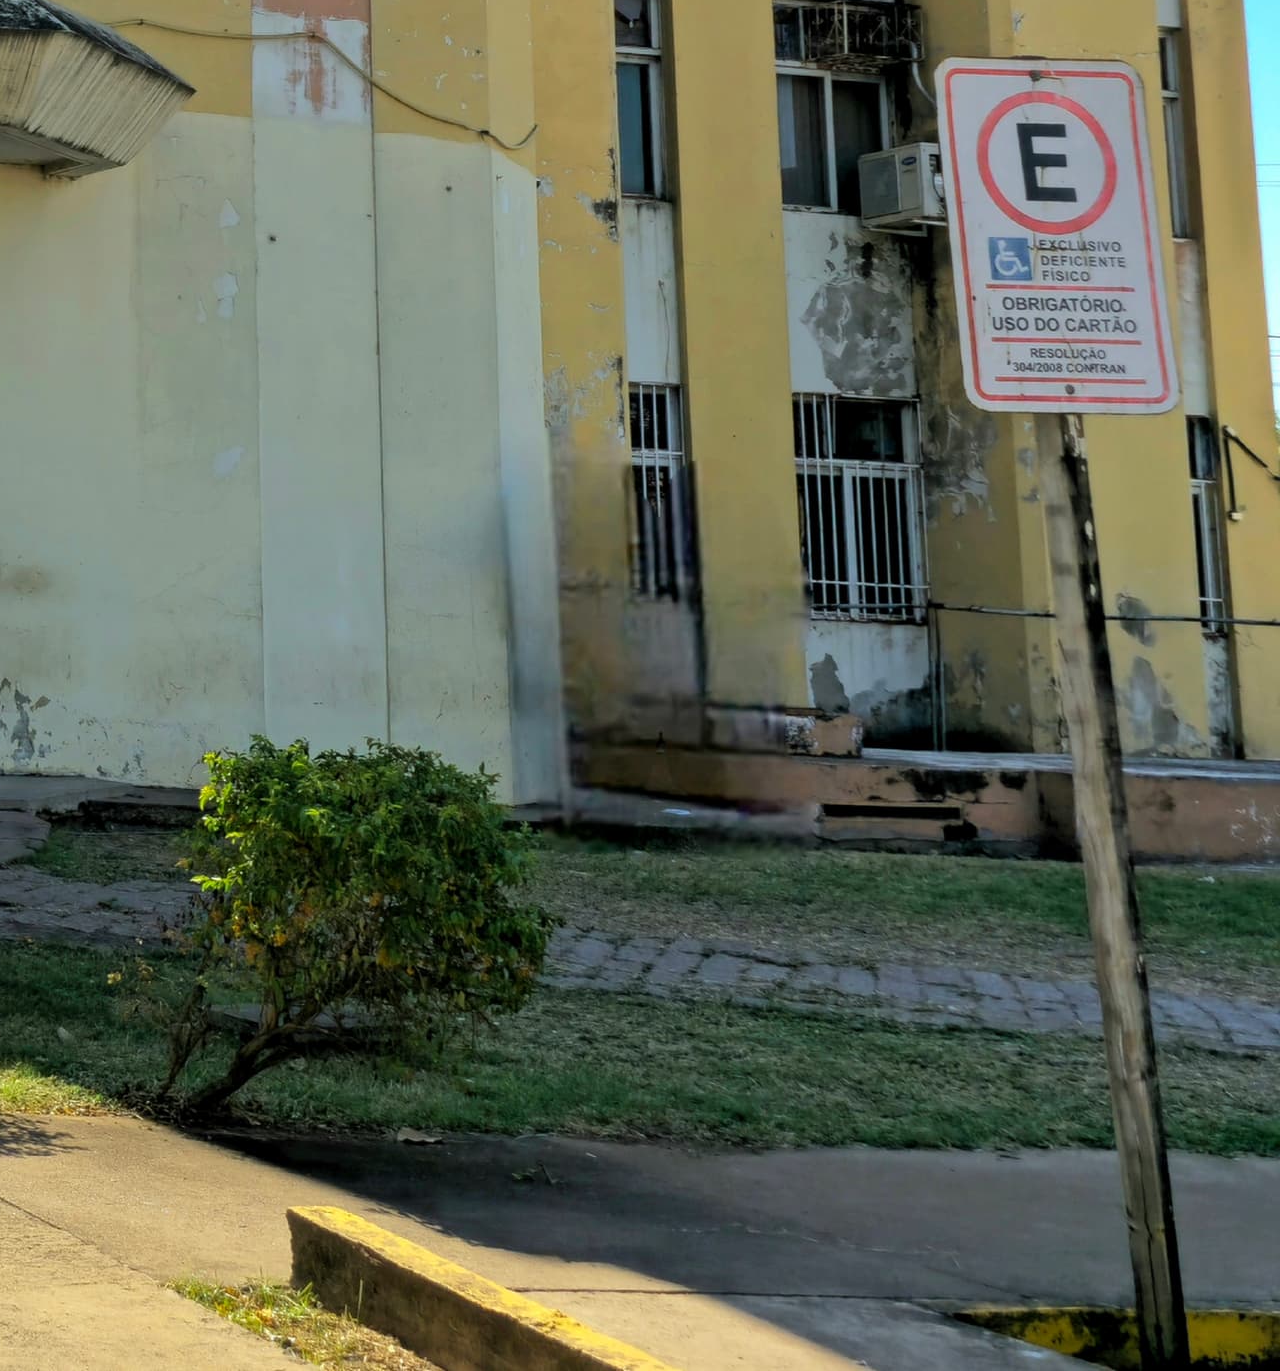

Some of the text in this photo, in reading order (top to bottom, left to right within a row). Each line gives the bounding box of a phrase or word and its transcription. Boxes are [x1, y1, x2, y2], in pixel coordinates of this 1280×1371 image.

[1016, 123, 1077, 202] E
[1038, 239, 1122, 253] EXCLUSIVO
[1041, 255, 1126, 268] DEFICIENTE
[1042, 269, 1091, 282] FÍSICO
[992, 316, 1137, 334] USO DO CARTÃO
[1030, 348, 1106, 361] RESOLUÇÃO
[1013, 362, 1126, 374] 304/2008 CONTRAN
